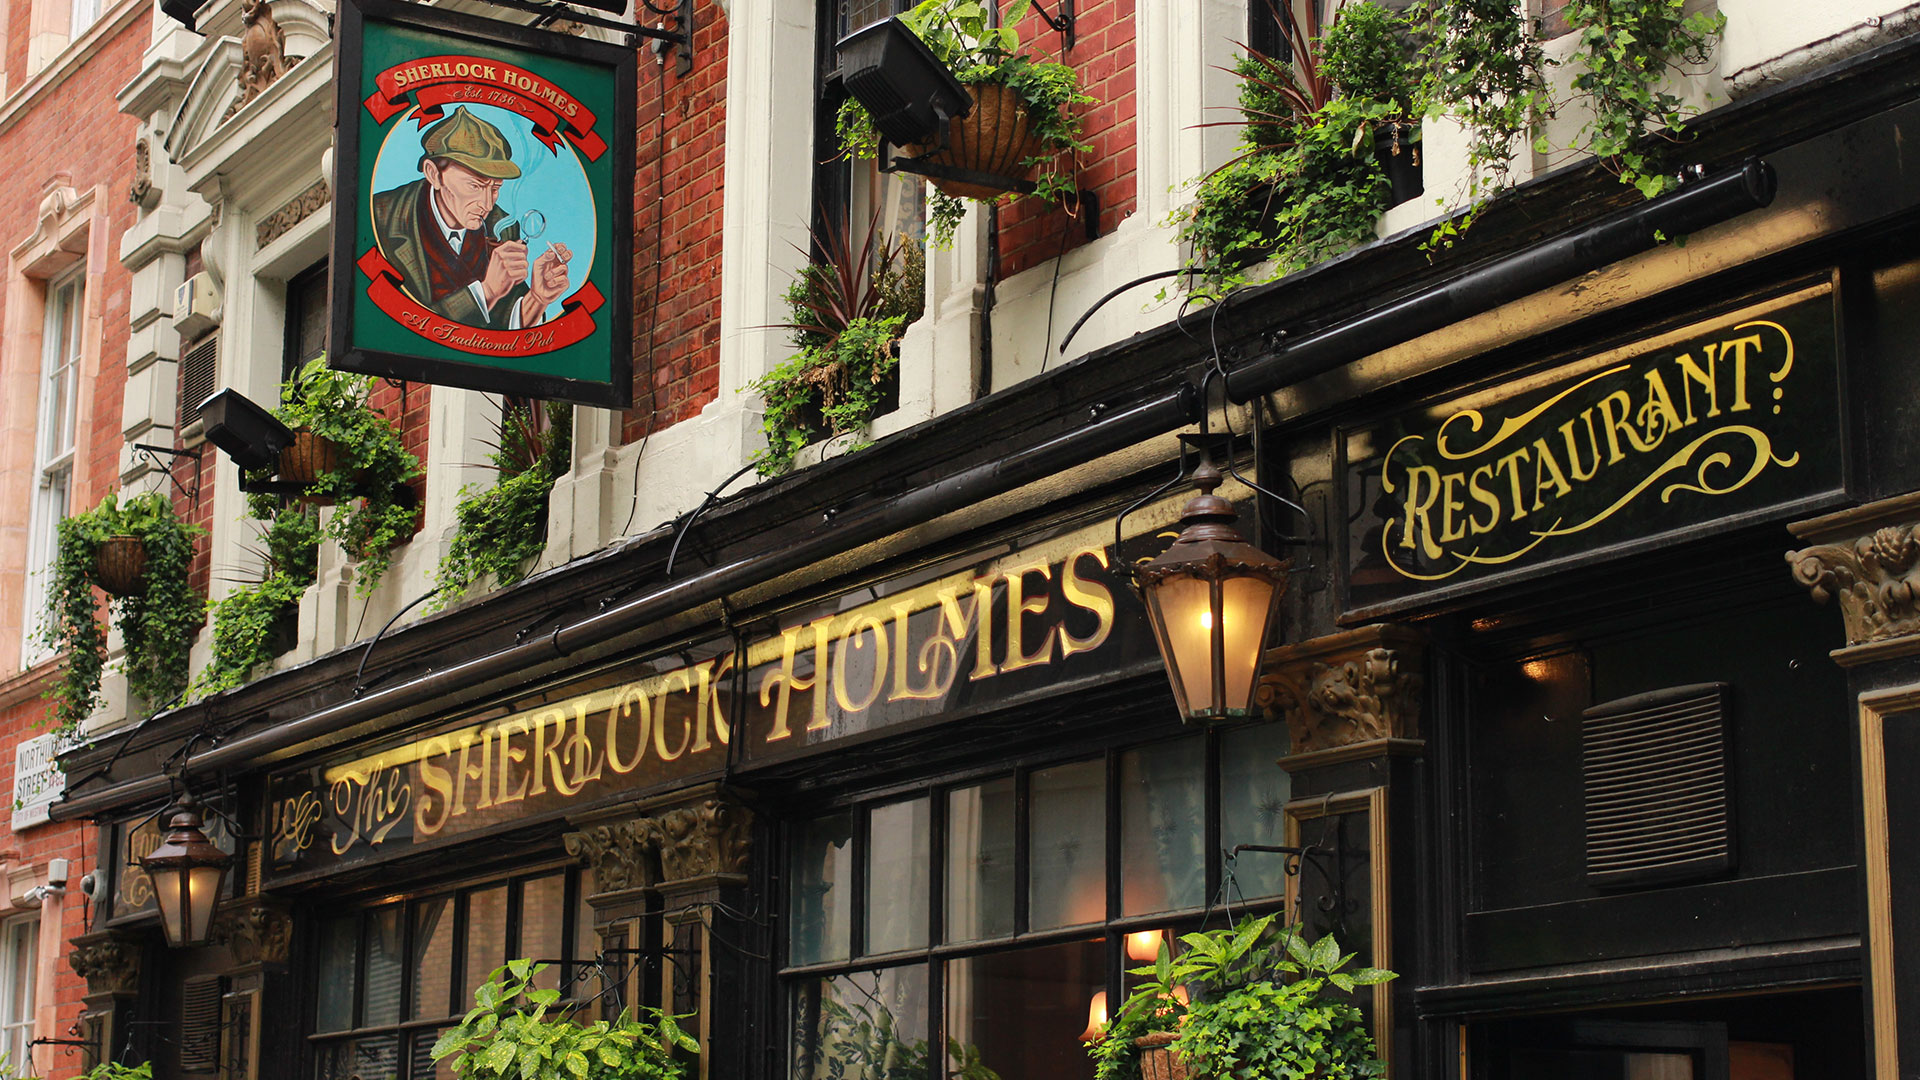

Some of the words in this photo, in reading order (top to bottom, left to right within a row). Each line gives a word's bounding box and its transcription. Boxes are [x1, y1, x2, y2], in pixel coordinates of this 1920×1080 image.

[394, 63, 497, 87] SHERLOCK
[503, 70, 579, 118] HOLMES
[487, 90, 517, 106] 1736
[402, 311, 430, 331] A
[433, 323, 520, 351] Traditional
[523, 330, 555, 350] Pub
[1399, 332, 1763, 561] RESTAURANT
[330, 759, 411, 855] The
[414, 651, 736, 837] SHERLOCK
[760, 544, 1116, 744] HOLMES
[18, 769, 45, 799] STREET
